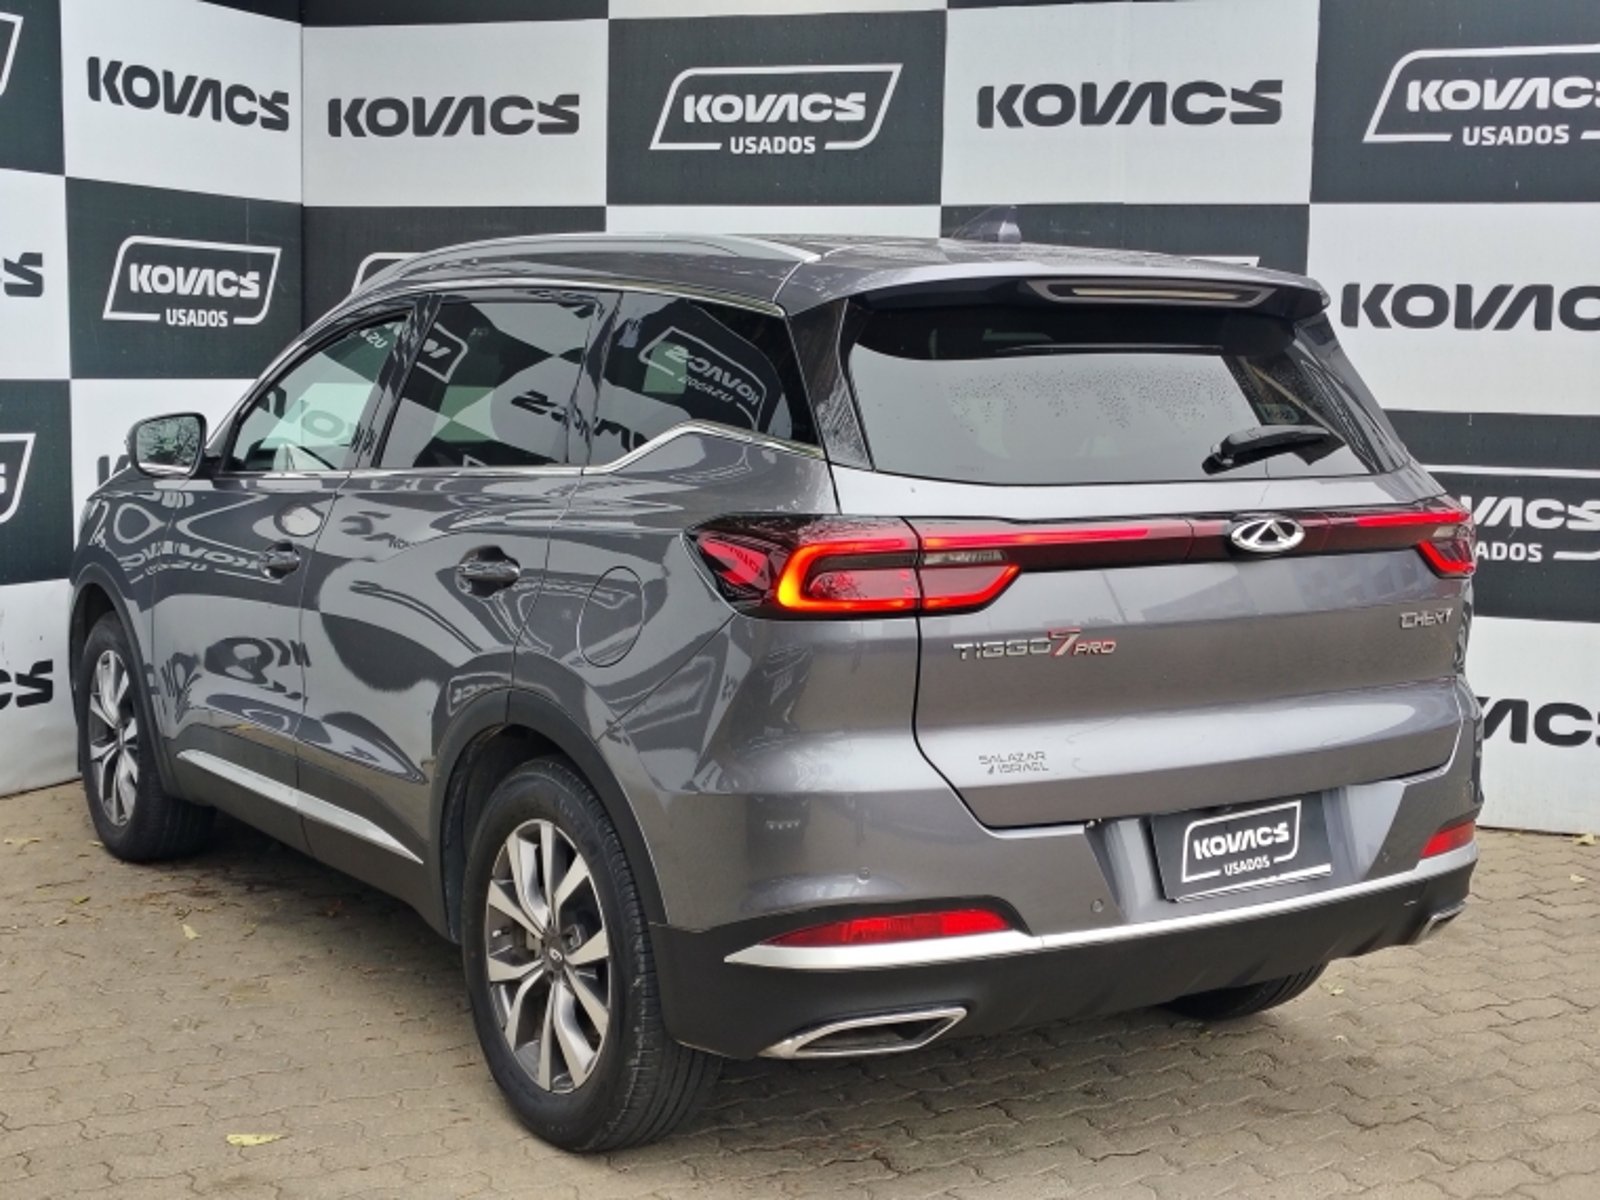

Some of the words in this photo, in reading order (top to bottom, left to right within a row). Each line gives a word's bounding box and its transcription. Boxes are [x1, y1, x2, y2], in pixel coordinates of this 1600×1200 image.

[88, 57, 289, 131] KOVACS
[683, 92, 866, 123] KOVACS
[977, 79, 1283, 128] KOVACS
[1406, 76, 1600, 112] KOVAC
[328, 94, 580, 137] KOVACS
[730, 136, 816, 154] USADOS
[1462, 124, 1570, 146] USADOS
[129, 263, 260, 299] KOVACS
[166, 308, 228, 328] USADOS
[952, 637, 1051, 660] TIGGO
[1073, 640, 1117, 656] PRO
[1475, 696, 1600, 747] AC
[1193, 821, 1290, 860] KOVACS
[1224, 854, 1271, 876] USADOS
